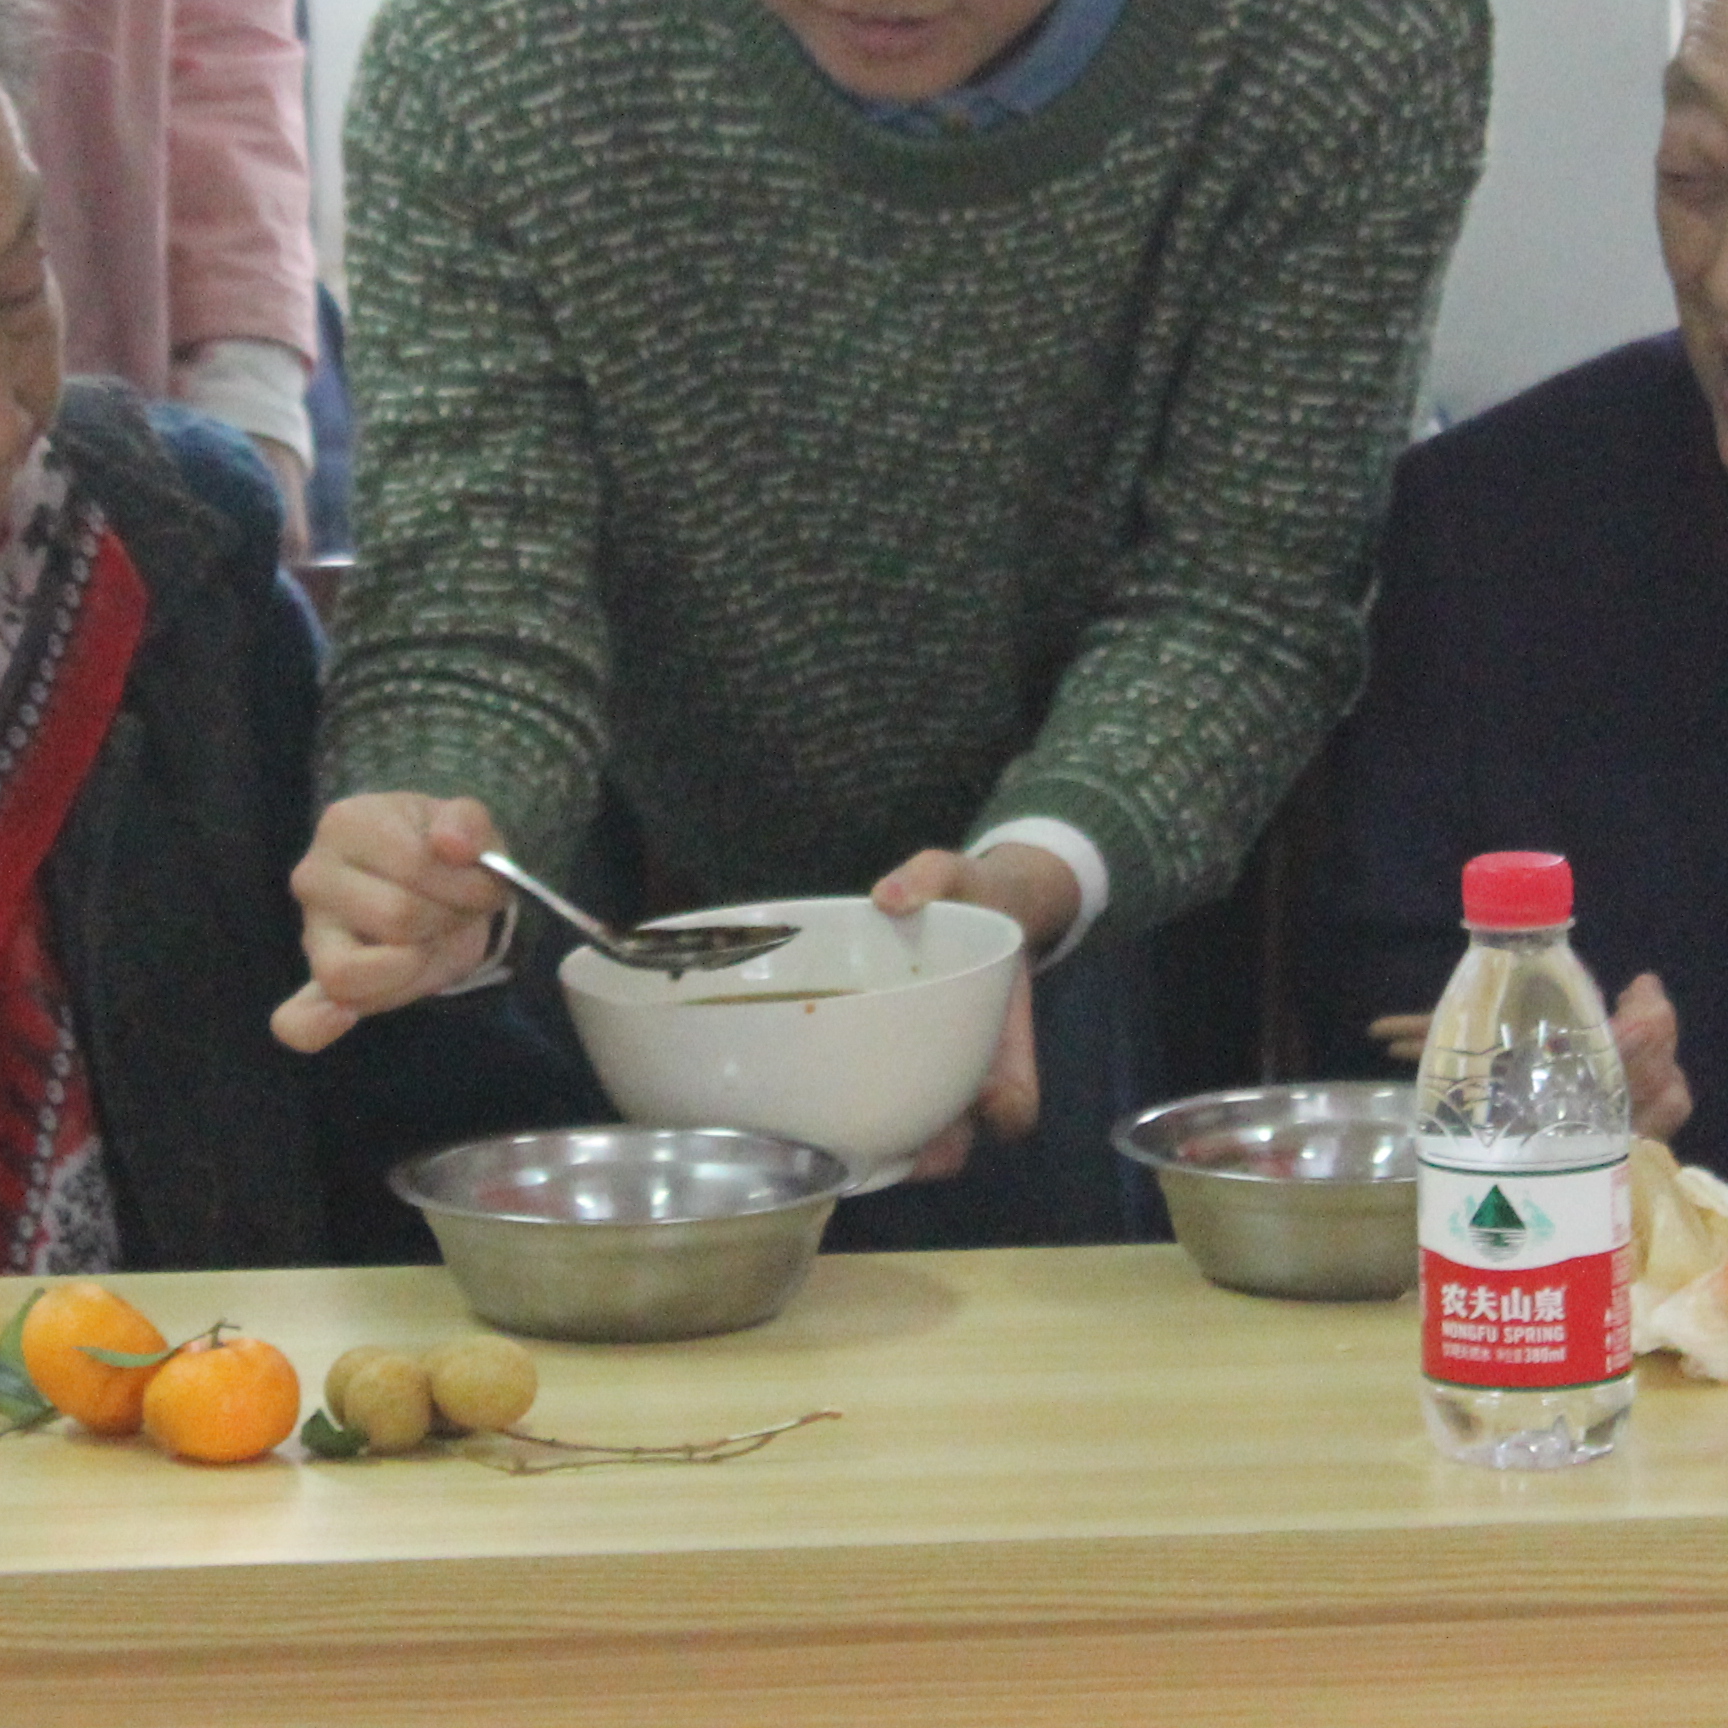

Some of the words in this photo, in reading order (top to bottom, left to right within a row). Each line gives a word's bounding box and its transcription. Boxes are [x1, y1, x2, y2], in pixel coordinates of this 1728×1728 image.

[1441, 1282, 1566, 1322] 农夫山泉
[1503, 1325, 1565, 1344] SPRING
